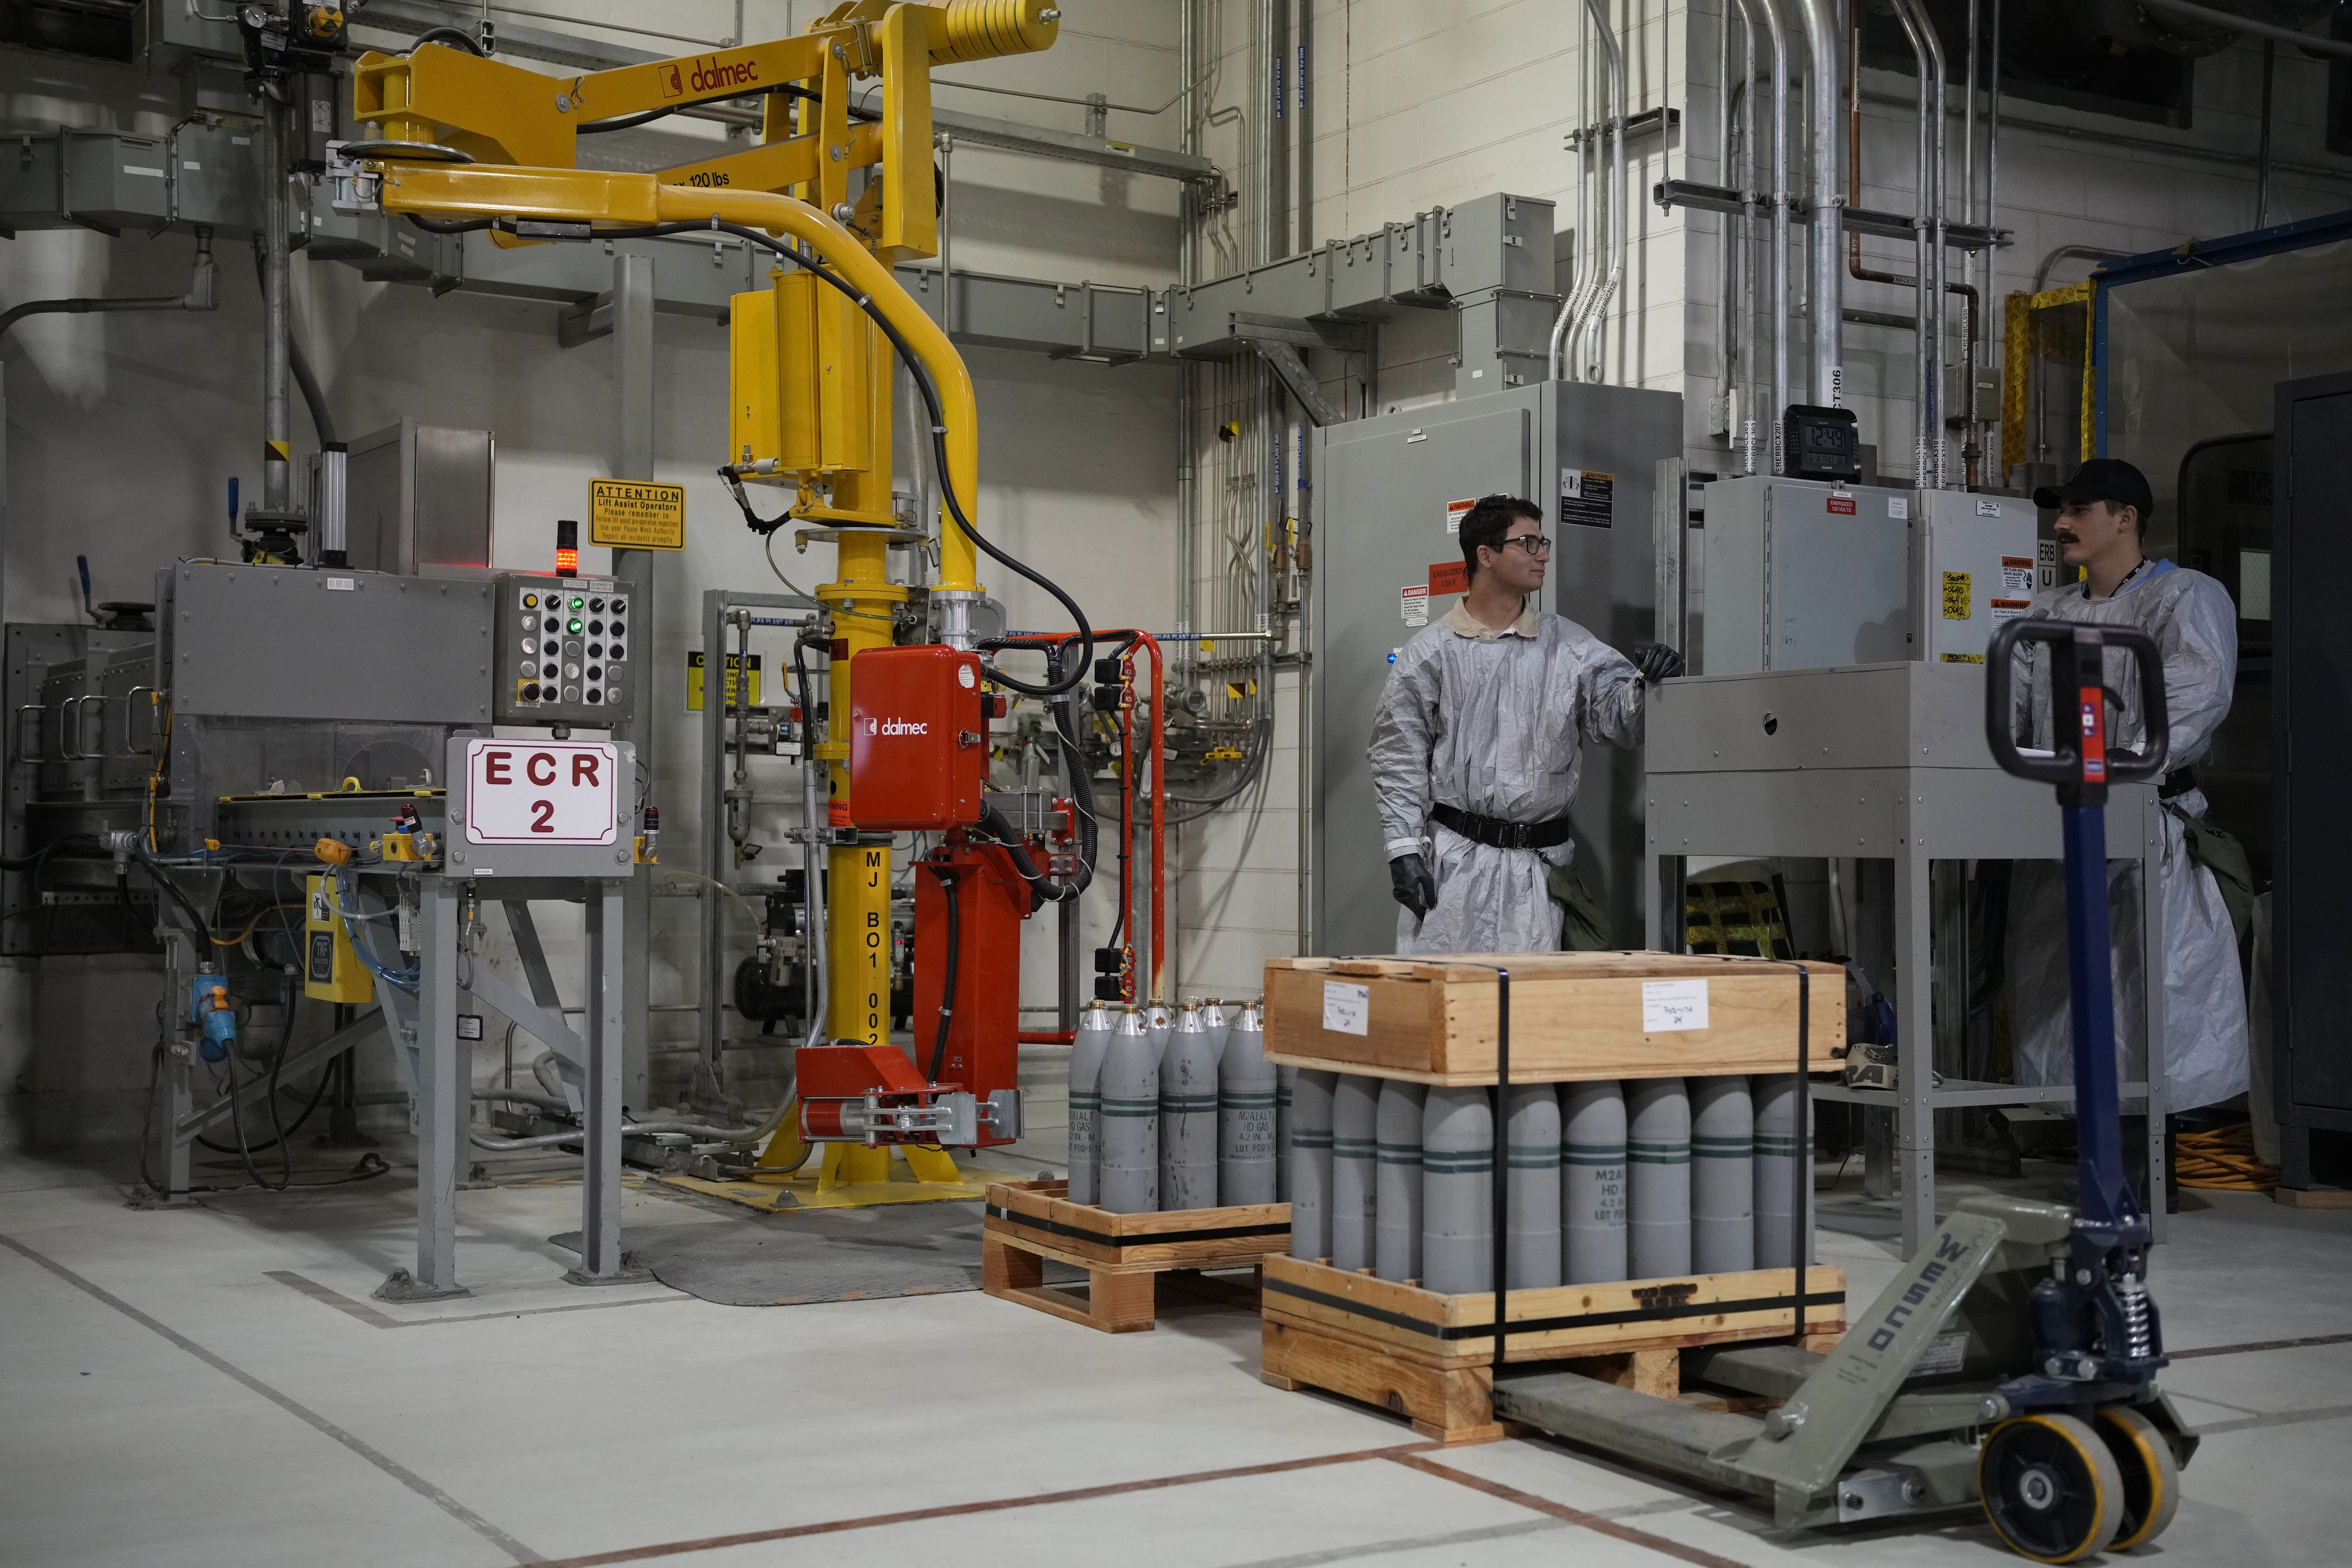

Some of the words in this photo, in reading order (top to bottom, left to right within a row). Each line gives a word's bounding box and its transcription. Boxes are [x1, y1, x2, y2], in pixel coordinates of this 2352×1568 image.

[691, 57, 758, 92] dalmec
[690, 173, 710, 187] 120
[712, 172, 729, 187] lbs
[1579, 286, 1599, 325] ERERBCZ084
[1597, 281, 1617, 318] ERERBCZ126
[1812, 427, 1843, 447] 12:49
[597, 486, 678, 500] ATTENTION
[598, 498, 611, 507] Lift
[614, 499, 637, 508] Assist
[640, 502, 676, 511] Operators
[1453, 501, 1474, 510] WARNING
[629, 511, 658, 519] remember
[2040, 543, 2054, 561] ERB
[1433, 568, 1463, 578] ENERGIZED
[2043, 570, 2052, 586] U
[882, 717, 927, 735] dalmec
[830, 802, 848, 811] RNING
[531, 800, 554, 833] 2
[316, 941, 328, 957] TKF
[869, 993, 878, 1046] 002
[1077, 1122, 1090, 1132] GAS
[1243, 1122, 1253, 1132] HD
[1256, 1122, 1269, 1132] GAS
[1239, 1132, 1250, 1141] 4.2
[1602, 1184, 1617, 1195] HD
[1867, 1233, 1968, 1354] WESCO
